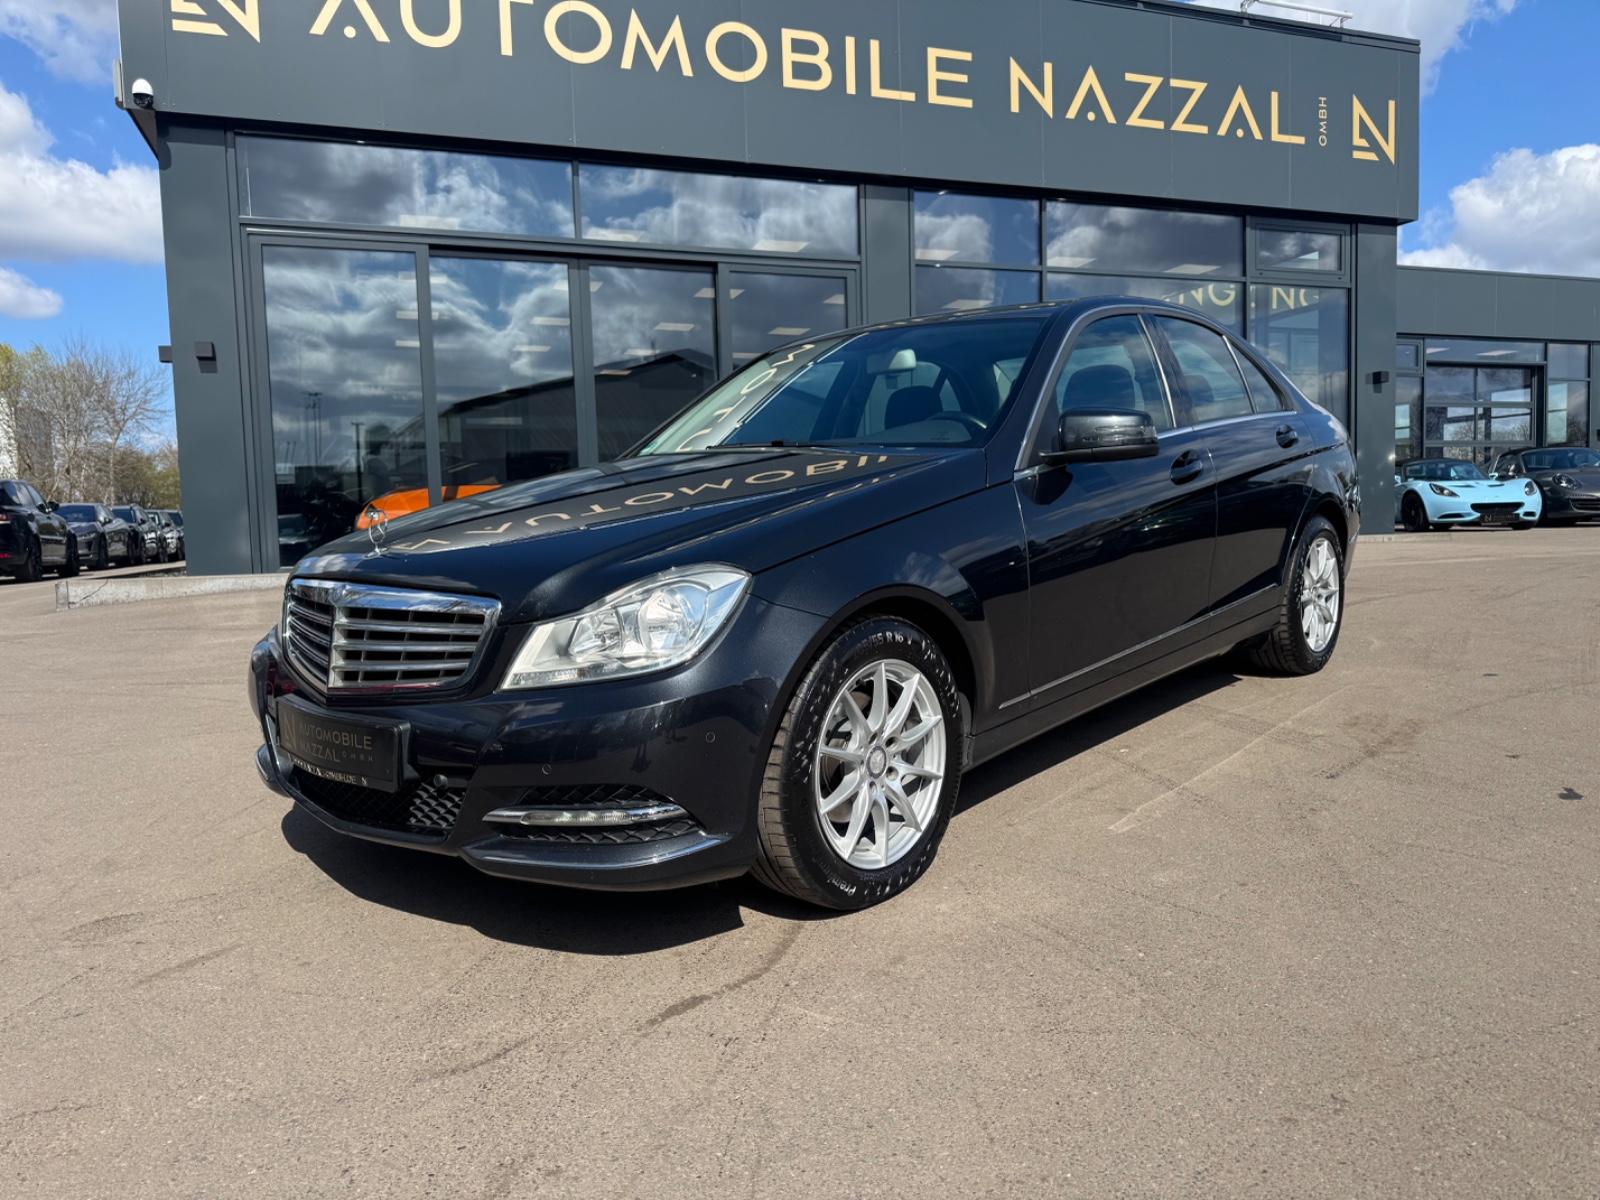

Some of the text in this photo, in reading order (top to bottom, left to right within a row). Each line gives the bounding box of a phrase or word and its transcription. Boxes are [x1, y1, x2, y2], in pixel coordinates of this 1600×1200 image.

[309, 0, 973, 108] AUTOMOBILE
[1009, 56, 1306, 146] NAZZAL
[1317, 96, 1328, 147] GMBH
[301, 722, 373, 750] UTOMOBILE
